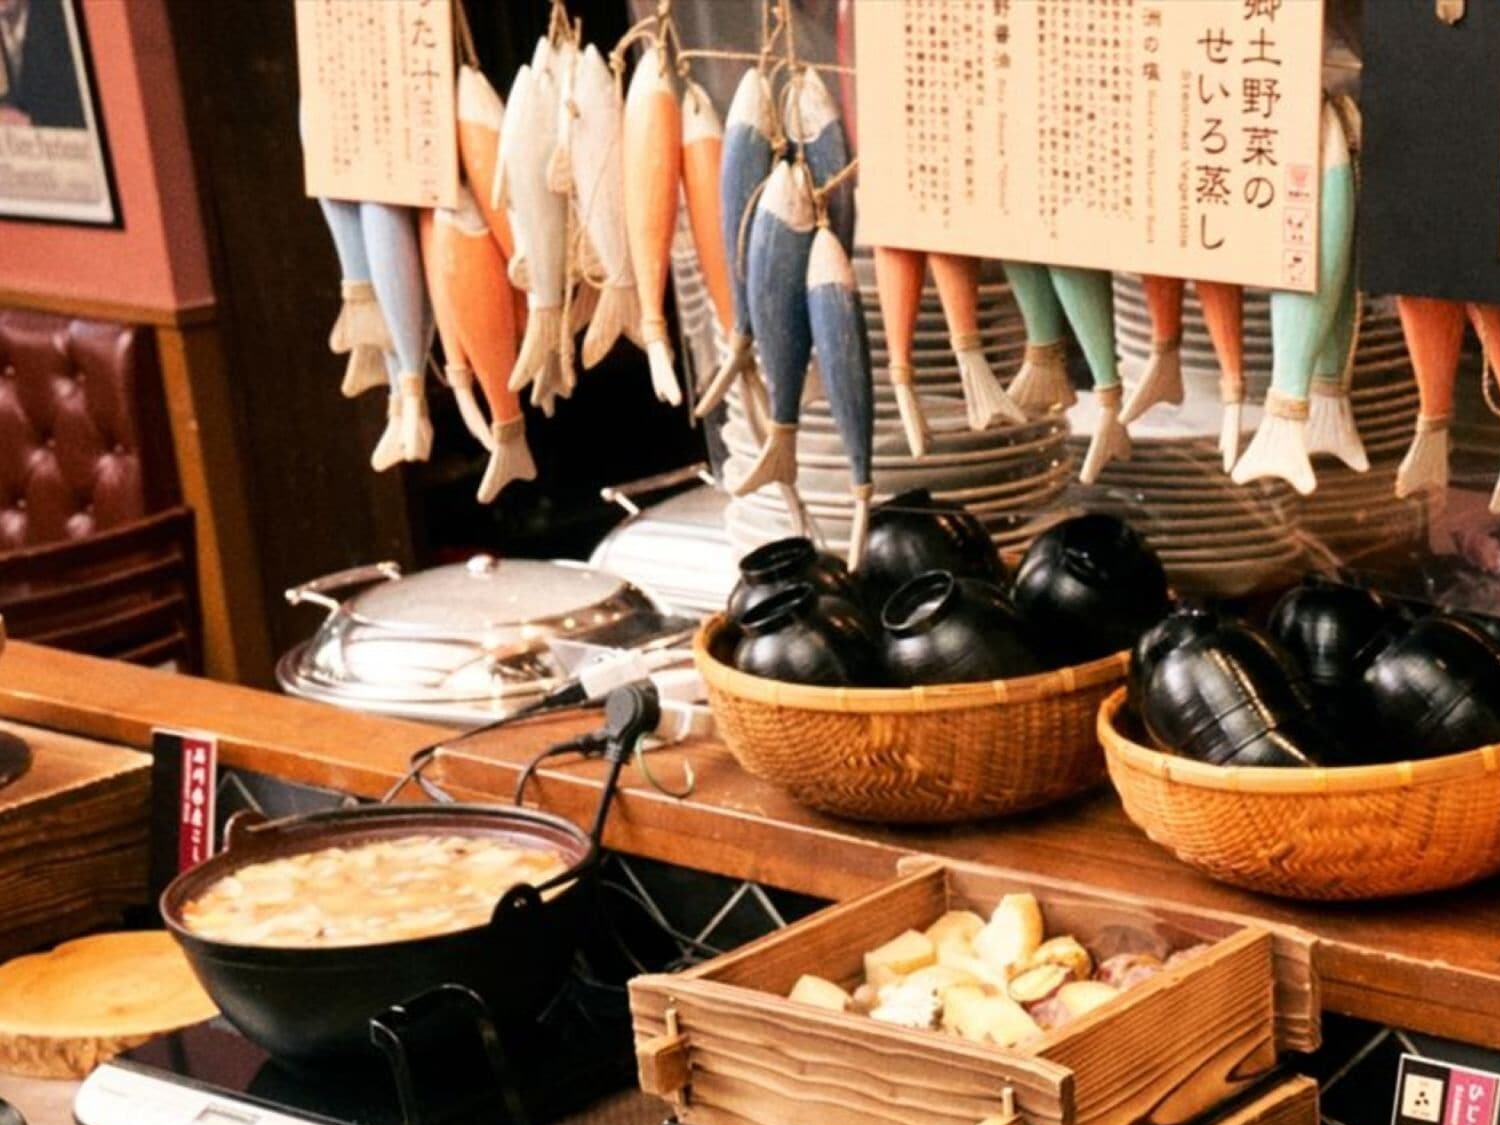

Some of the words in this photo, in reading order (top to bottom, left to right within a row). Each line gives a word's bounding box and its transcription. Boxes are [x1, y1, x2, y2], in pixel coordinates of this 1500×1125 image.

[1195, 27, 1233, 250] せいろ蒸し
